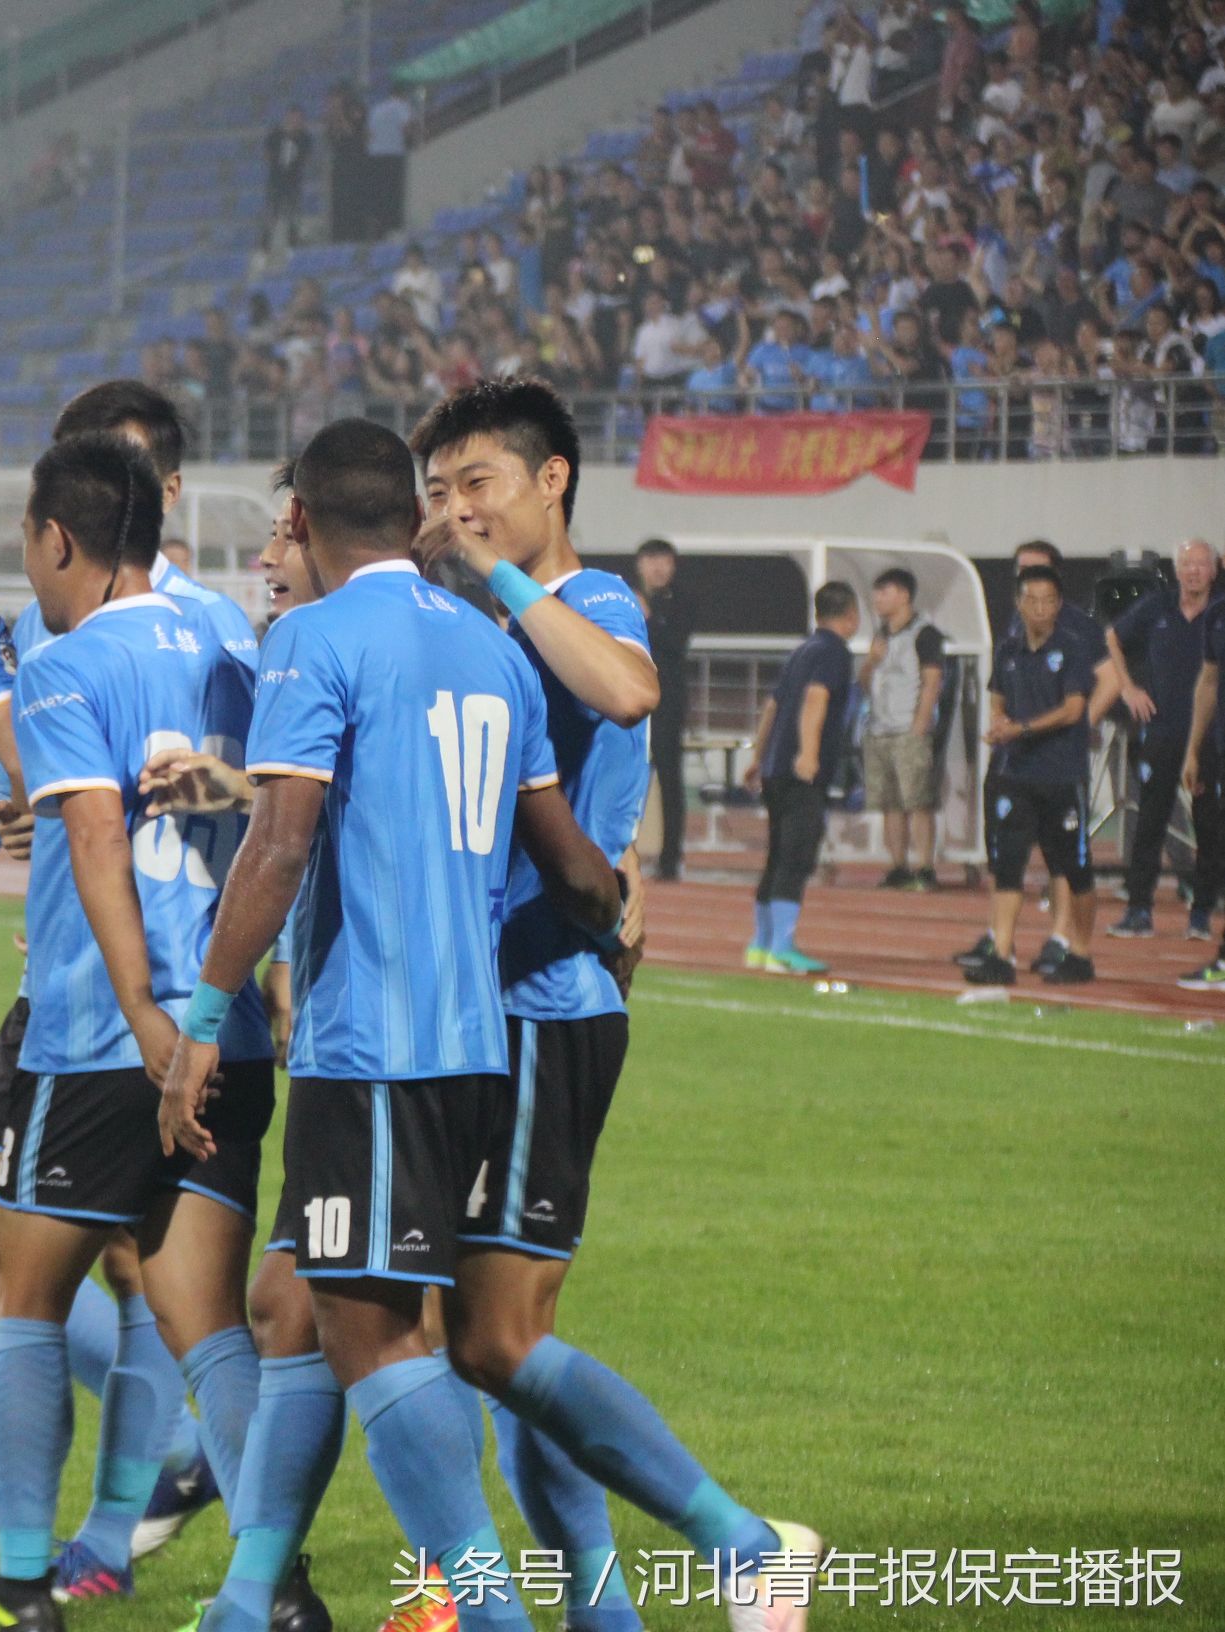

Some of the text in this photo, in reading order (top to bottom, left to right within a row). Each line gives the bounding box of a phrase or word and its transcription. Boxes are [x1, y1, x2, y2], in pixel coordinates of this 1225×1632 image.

[426, 689, 511, 856] 10
[303, 1195, 352, 1260] 10
[392, 1243, 431, 1253] MUSTART
